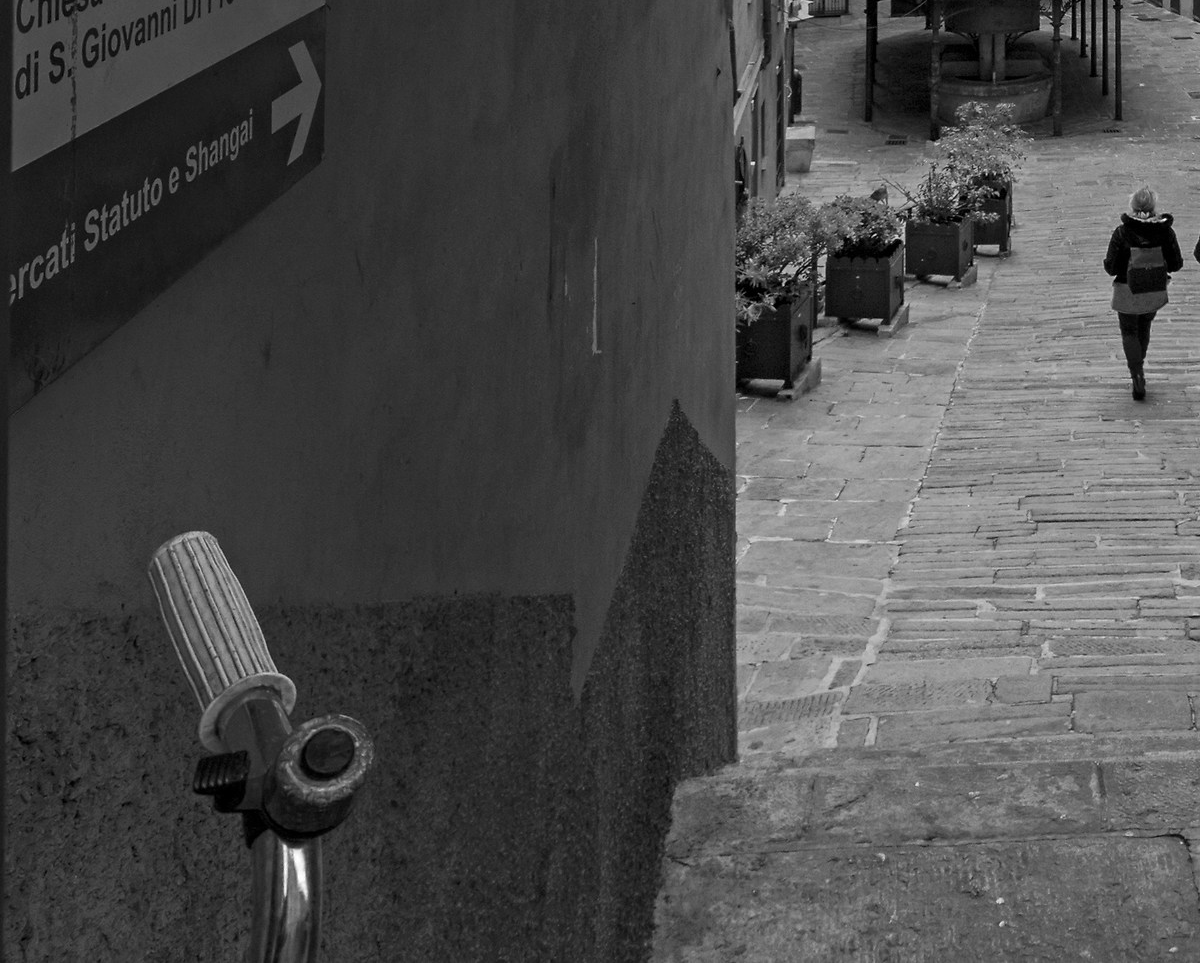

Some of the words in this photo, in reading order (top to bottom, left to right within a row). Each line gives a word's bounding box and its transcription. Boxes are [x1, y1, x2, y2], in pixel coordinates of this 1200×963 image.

[15, 50, 40, 100] di
[49, 41, 72, 84] S.
[84, 178, 163, 252] Statuto
[168, 165, 180, 194] e
[186, 108, 254, 183] Shangai
